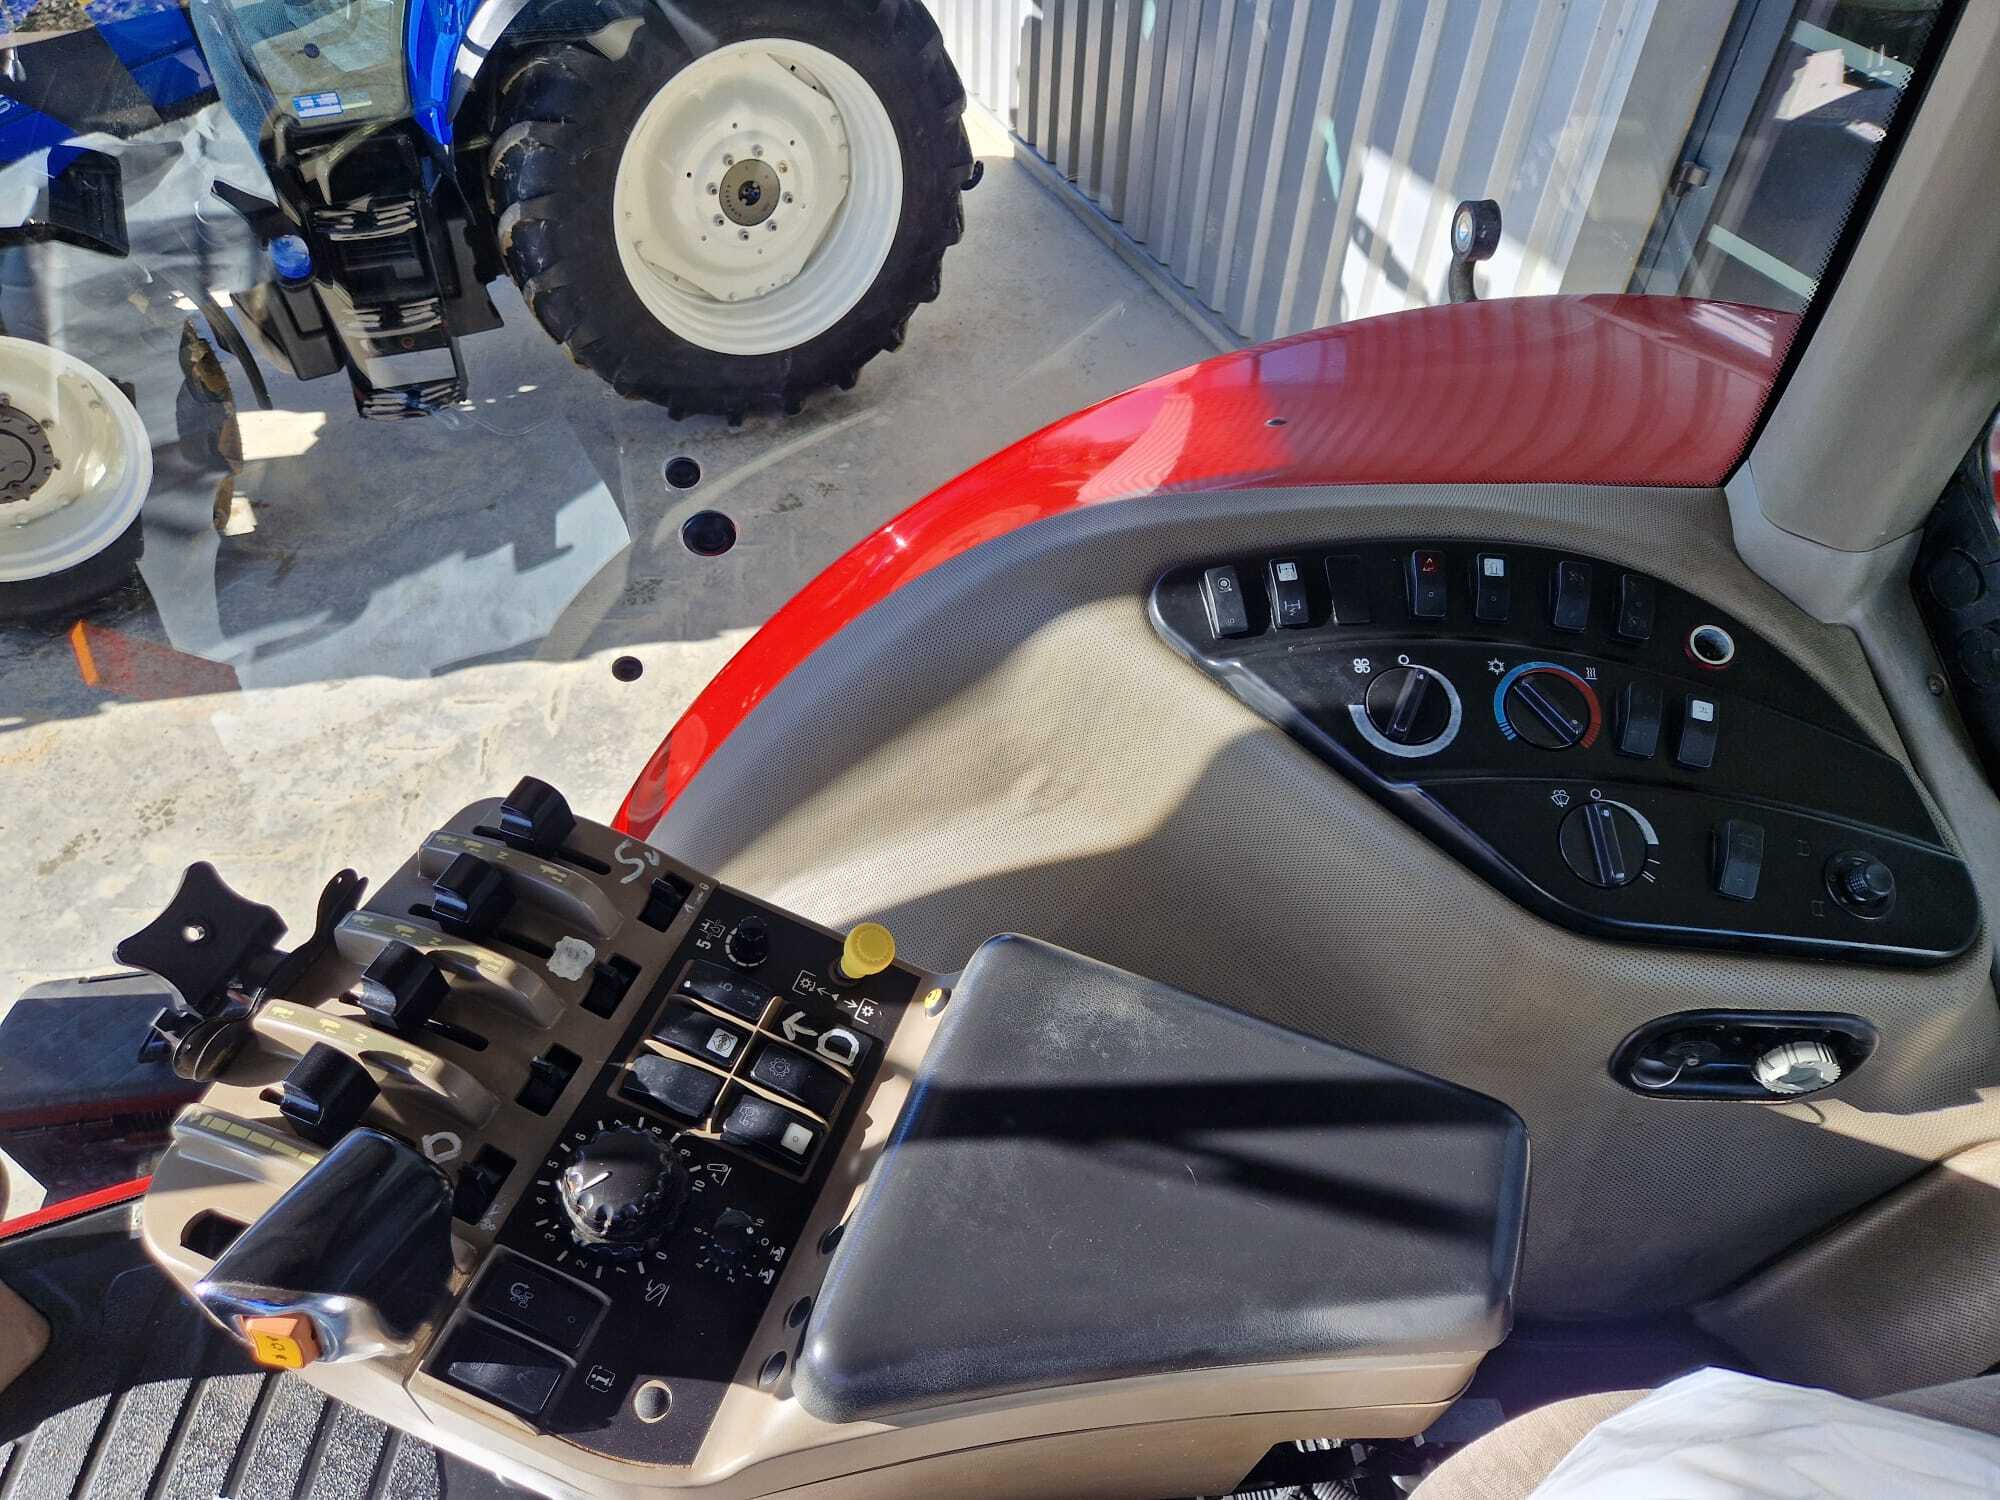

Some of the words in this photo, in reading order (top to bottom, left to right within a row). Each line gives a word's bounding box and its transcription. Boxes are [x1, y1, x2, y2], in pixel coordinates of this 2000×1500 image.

[696, 939, 711, 950] 5
[651, 1125, 663, 1136] 8
[575, 1132, 587, 1142] 6
[680, 1147, 692, 1158] 9
[548, 1159, 559, 1169] 5
[691, 1179, 706, 1192] 10
[536, 1196, 547, 1206] 4
[545, 1232, 556, 1242] 3
[656, 1251, 668, 1261] 0
[575, 1259, 588, 1270] 2
[616, 1266, 628, 1274] 1
